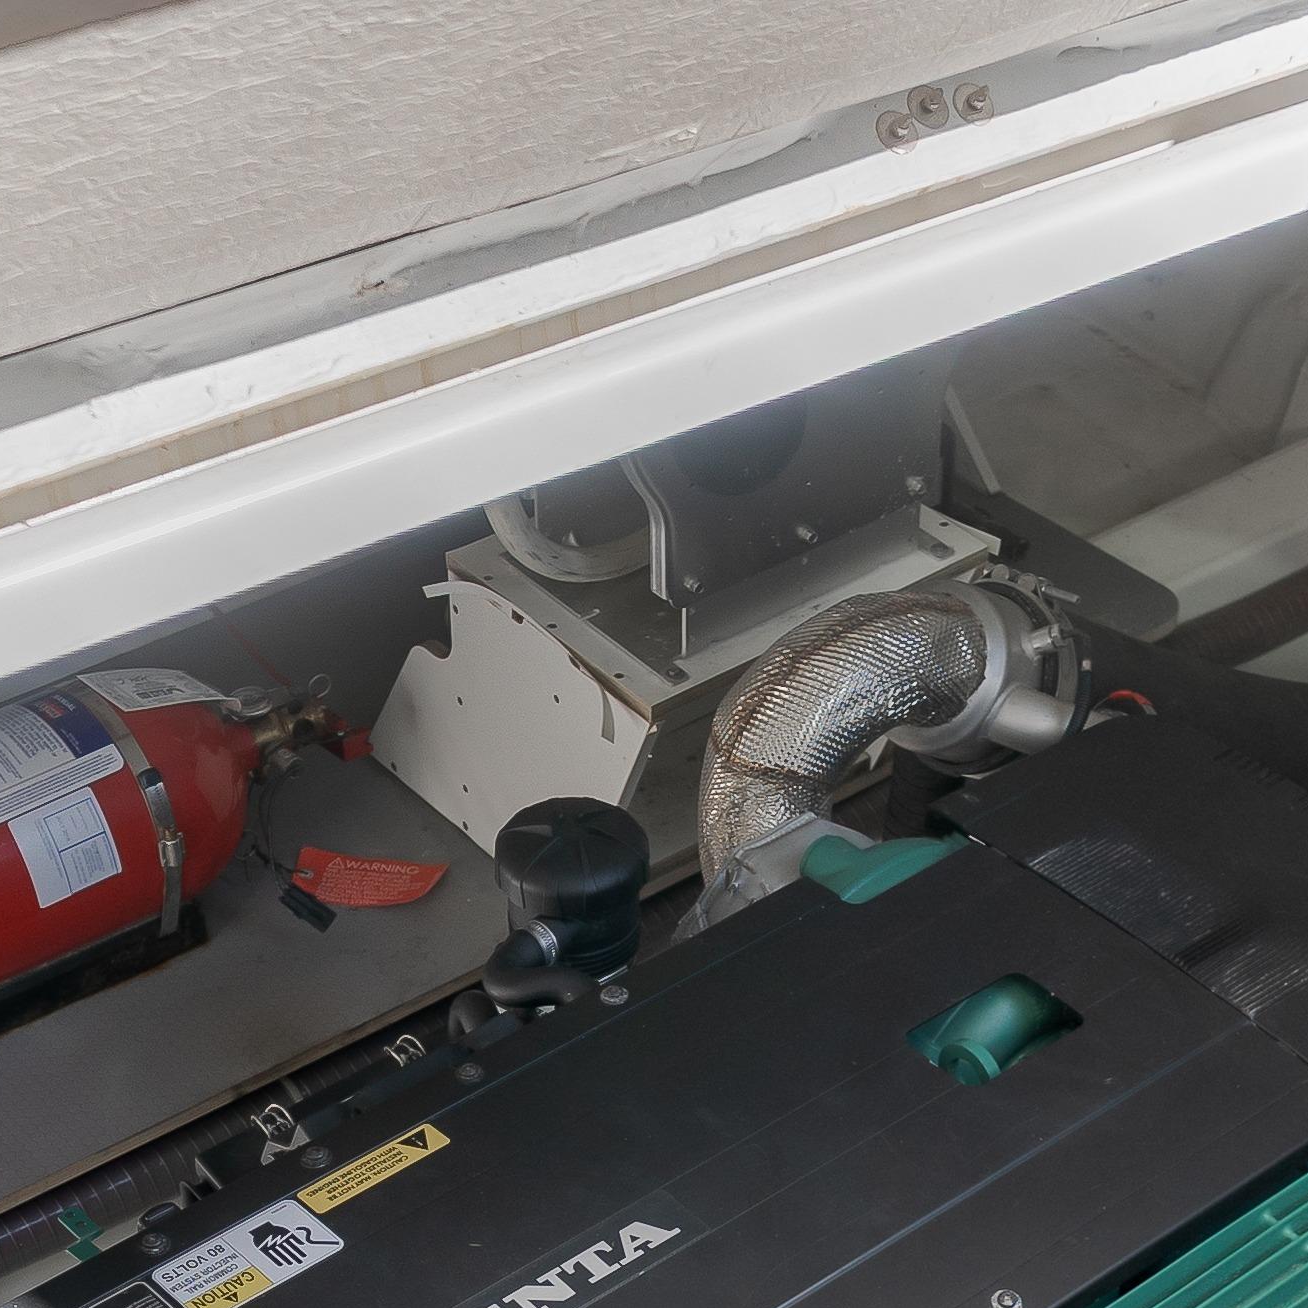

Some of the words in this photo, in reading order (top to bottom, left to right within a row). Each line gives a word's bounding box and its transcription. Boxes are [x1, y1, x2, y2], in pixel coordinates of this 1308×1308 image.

[345, 859, 420, 875] WARNING
[364, 1150, 403, 1174] INSTALLED
[372, 1155, 409, 1177] CAUTION:
[339, 1184, 356, 1197] NOT
[206, 1243, 226, 1258] 80
[161, 1255, 209, 1283] VOLTS
[200, 1252, 240, 1276] INJECTOR
[169, 1272, 202, 1293] SYSTEM
[203, 1263, 239, 1288] COMMON
[184, 1282, 204, 1295] RAIL
